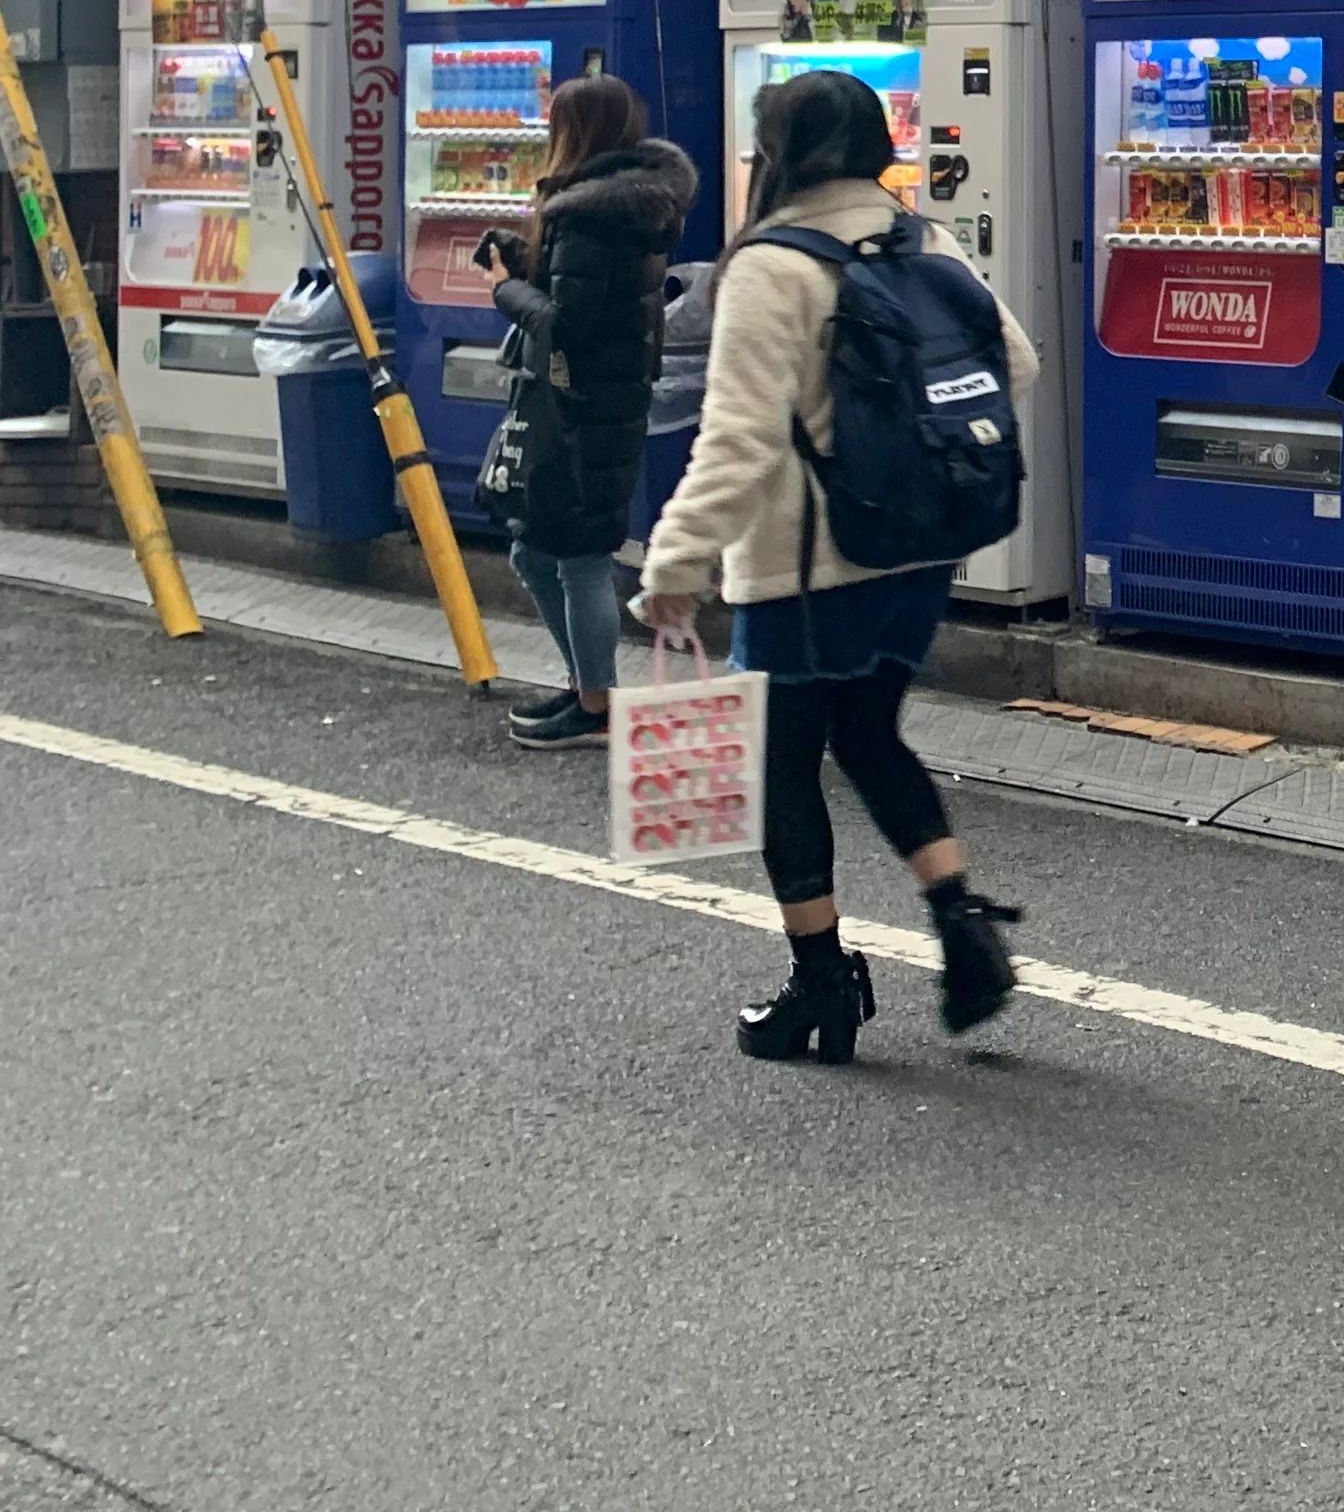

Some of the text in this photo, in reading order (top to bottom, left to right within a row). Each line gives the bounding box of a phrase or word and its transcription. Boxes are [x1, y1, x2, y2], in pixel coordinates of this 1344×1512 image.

[1170, 290, 1258, 324] WONDA
[1164, 323, 1242, 337] WONDERFUL COFFEE
